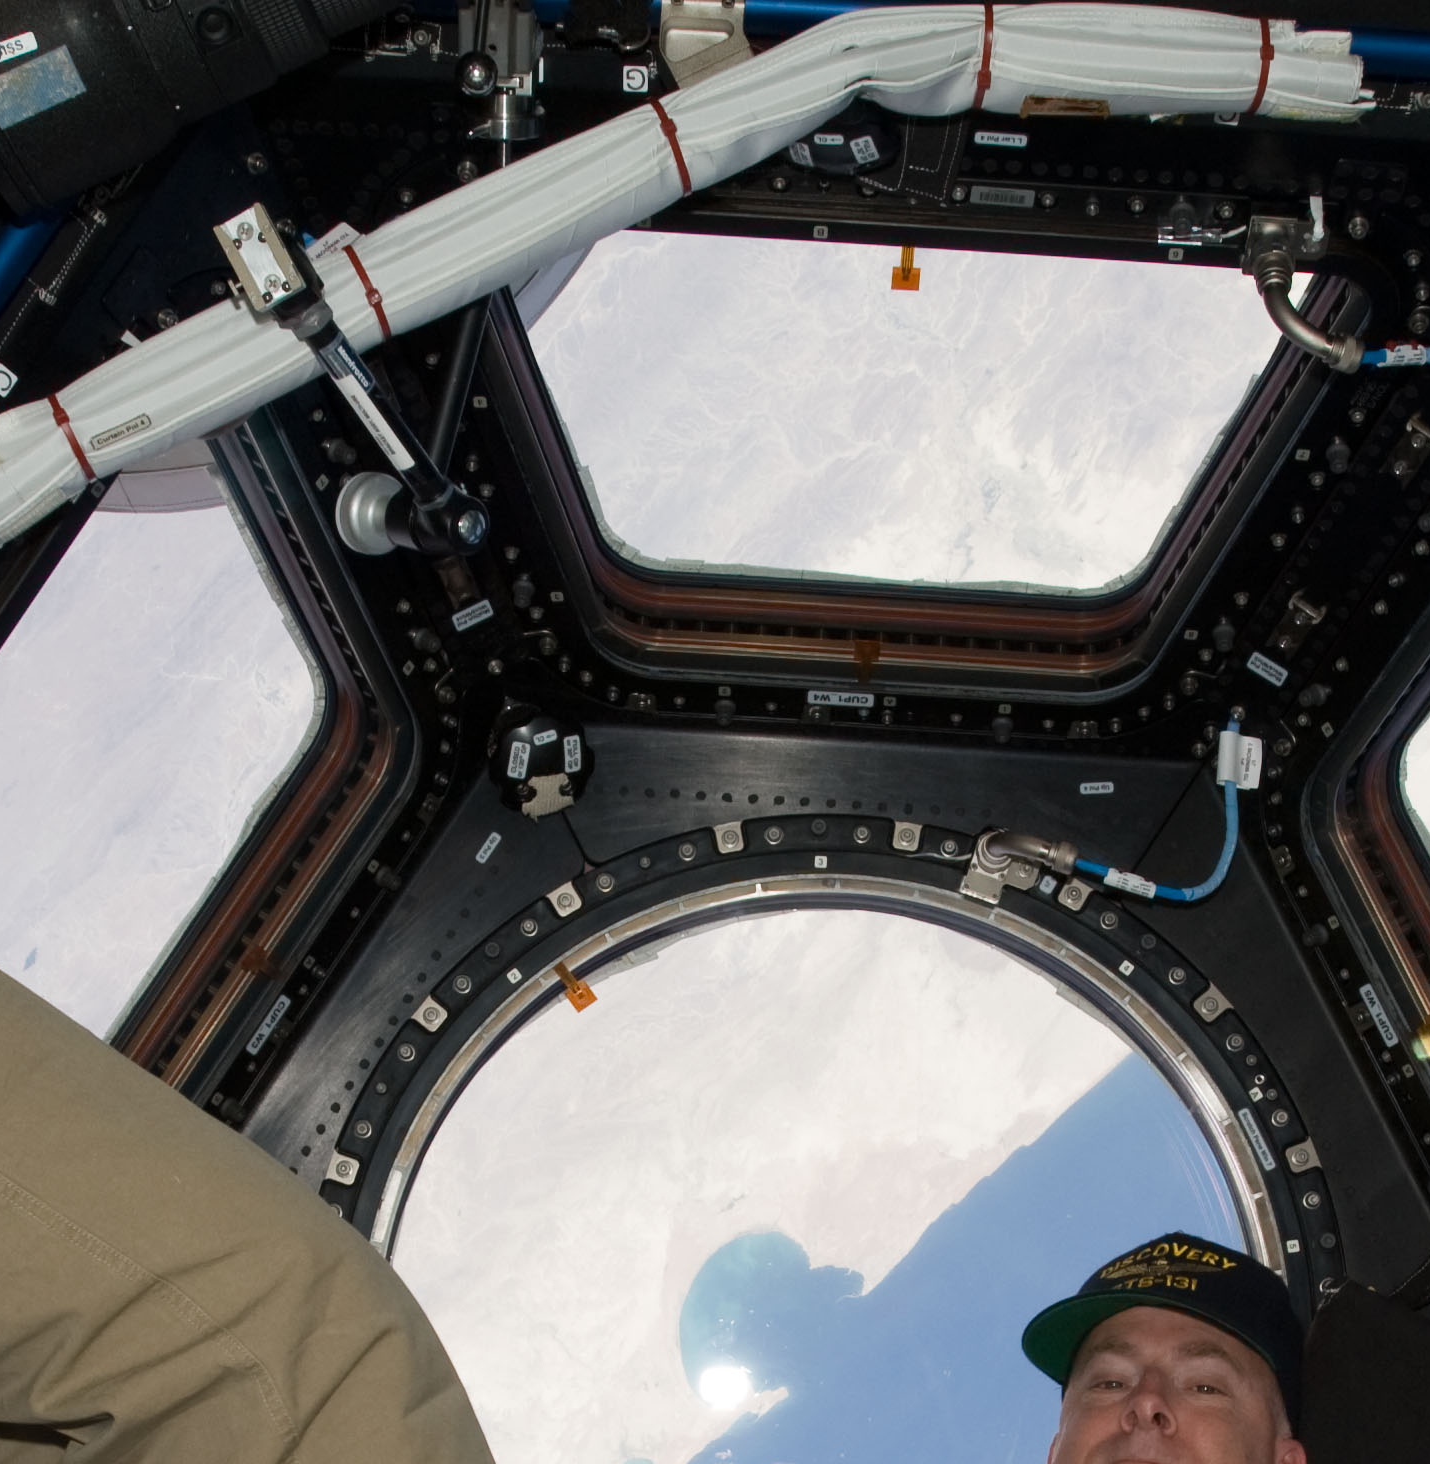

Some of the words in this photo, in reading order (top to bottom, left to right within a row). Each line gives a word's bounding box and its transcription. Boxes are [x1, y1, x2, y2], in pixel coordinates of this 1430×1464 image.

[626, 69, 645, 90] G
[337, 345, 370, 389] Manfrotto
[97, 428, 126, 446] Curtain
[126, 423, 139, 435] Pnl
[249, 1000, 286, 1051] CUP1_W3
[1100, 1242, 1238, 1279] DISCOVERY
